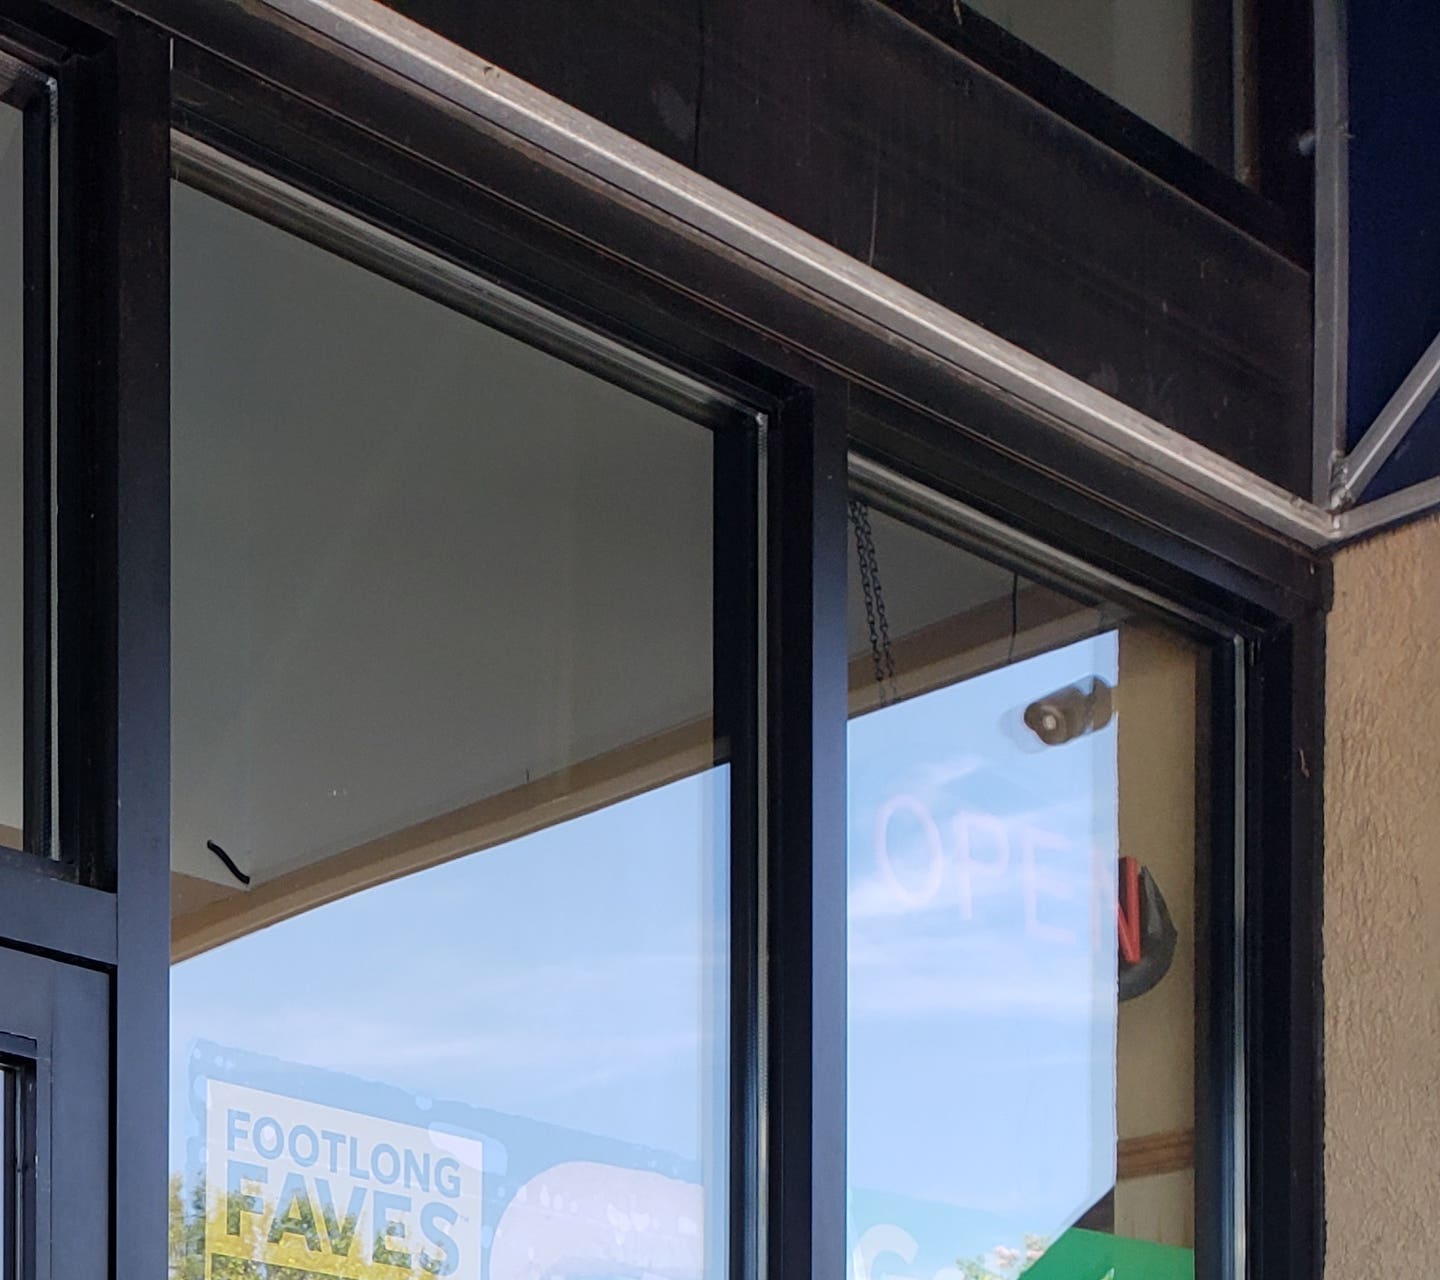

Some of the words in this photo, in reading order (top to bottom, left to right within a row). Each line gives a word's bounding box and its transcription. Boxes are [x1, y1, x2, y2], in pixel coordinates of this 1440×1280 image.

[874, 793, 1143, 966] OPEN
[226, 1108, 461, 1199] FOOTLONG
[226, 1159, 460, 1277] FAVES
